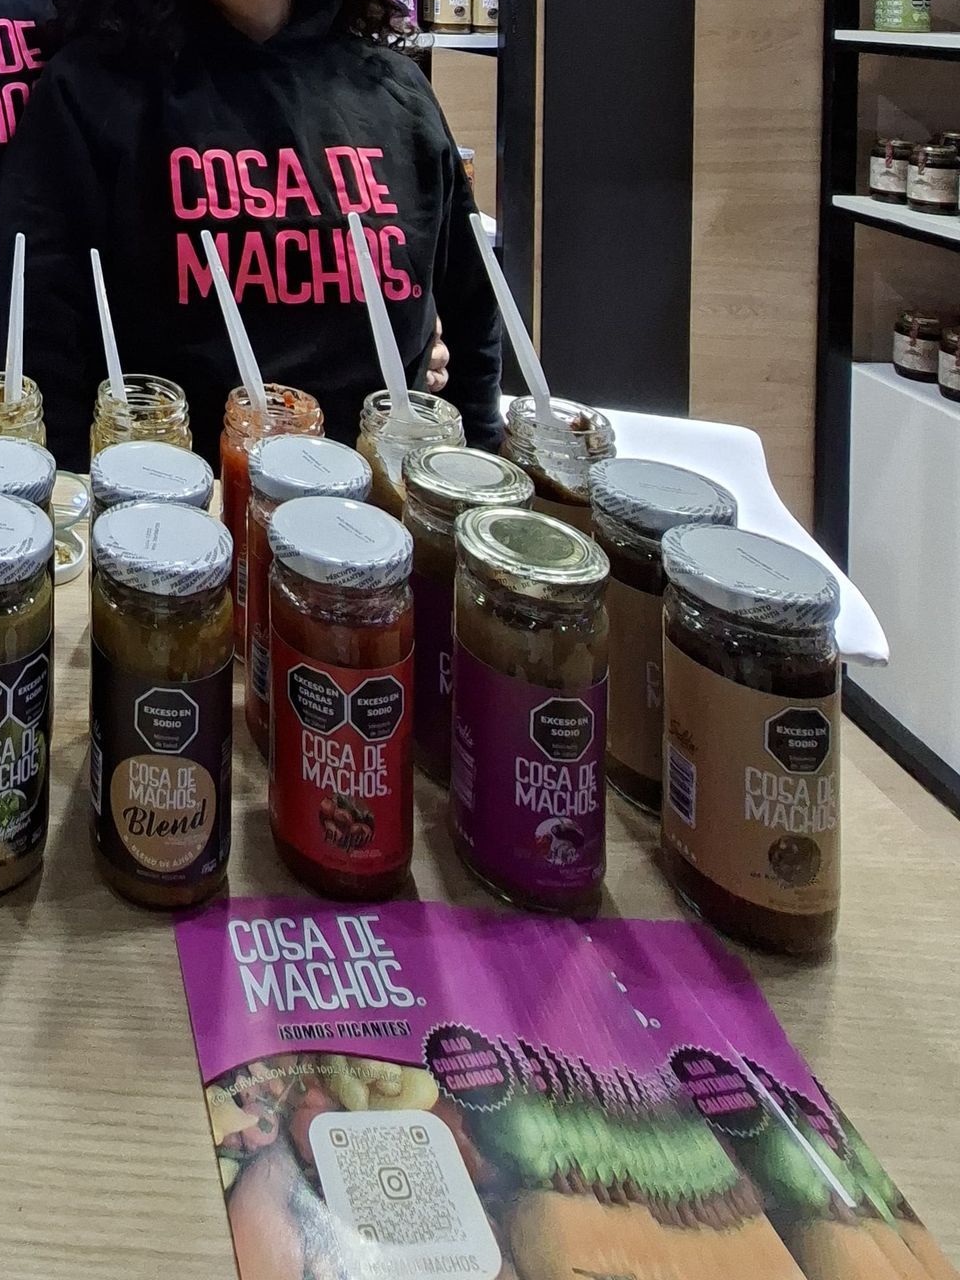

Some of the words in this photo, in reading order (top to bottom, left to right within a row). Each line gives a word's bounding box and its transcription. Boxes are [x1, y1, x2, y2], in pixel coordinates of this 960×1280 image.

[170, 146, 322, 220] COSA
[324, 145, 398, 216] DE
[294, 672, 325, 694] EXCESO
[326, 687, 339, 698] EN
[298, 685, 333, 706] GRASAS
[143, 705, 178, 717] EXCESO
[179, 708, 192, 717] EN
[297, 695, 335, 716] TOTALES
[357, 695, 389, 706] EXCESO
[389, 692, 400, 702] EN
[367, 706, 392, 717] SODIO
[541, 716, 577, 726] EXCESO
[578, 717, 589, 725] EN
[153, 719, 182, 729] SODIO
[551, 729, 580, 737] SODIO
[776, 725, 814, 737] EXCESO
[21, 722, 40, 758] DE
[302, 729, 356, 771] COSA
[364, 743, 387, 772] DE
[129, 759, 172, 789] COSA
[177, 767, 197, 789] DE
[515, 756, 572, 792] COSA
[579, 760, 598, 789] DE
[515, 781, 597, 817] MACHOS
[745, 767, 810, 807] COSA
[123, 798, 208, 838] Blend
[228, 916, 336, 963] COSA
[336, 915, 395, 959] DE
[445, 1067, 504, 1090] CALORICO
